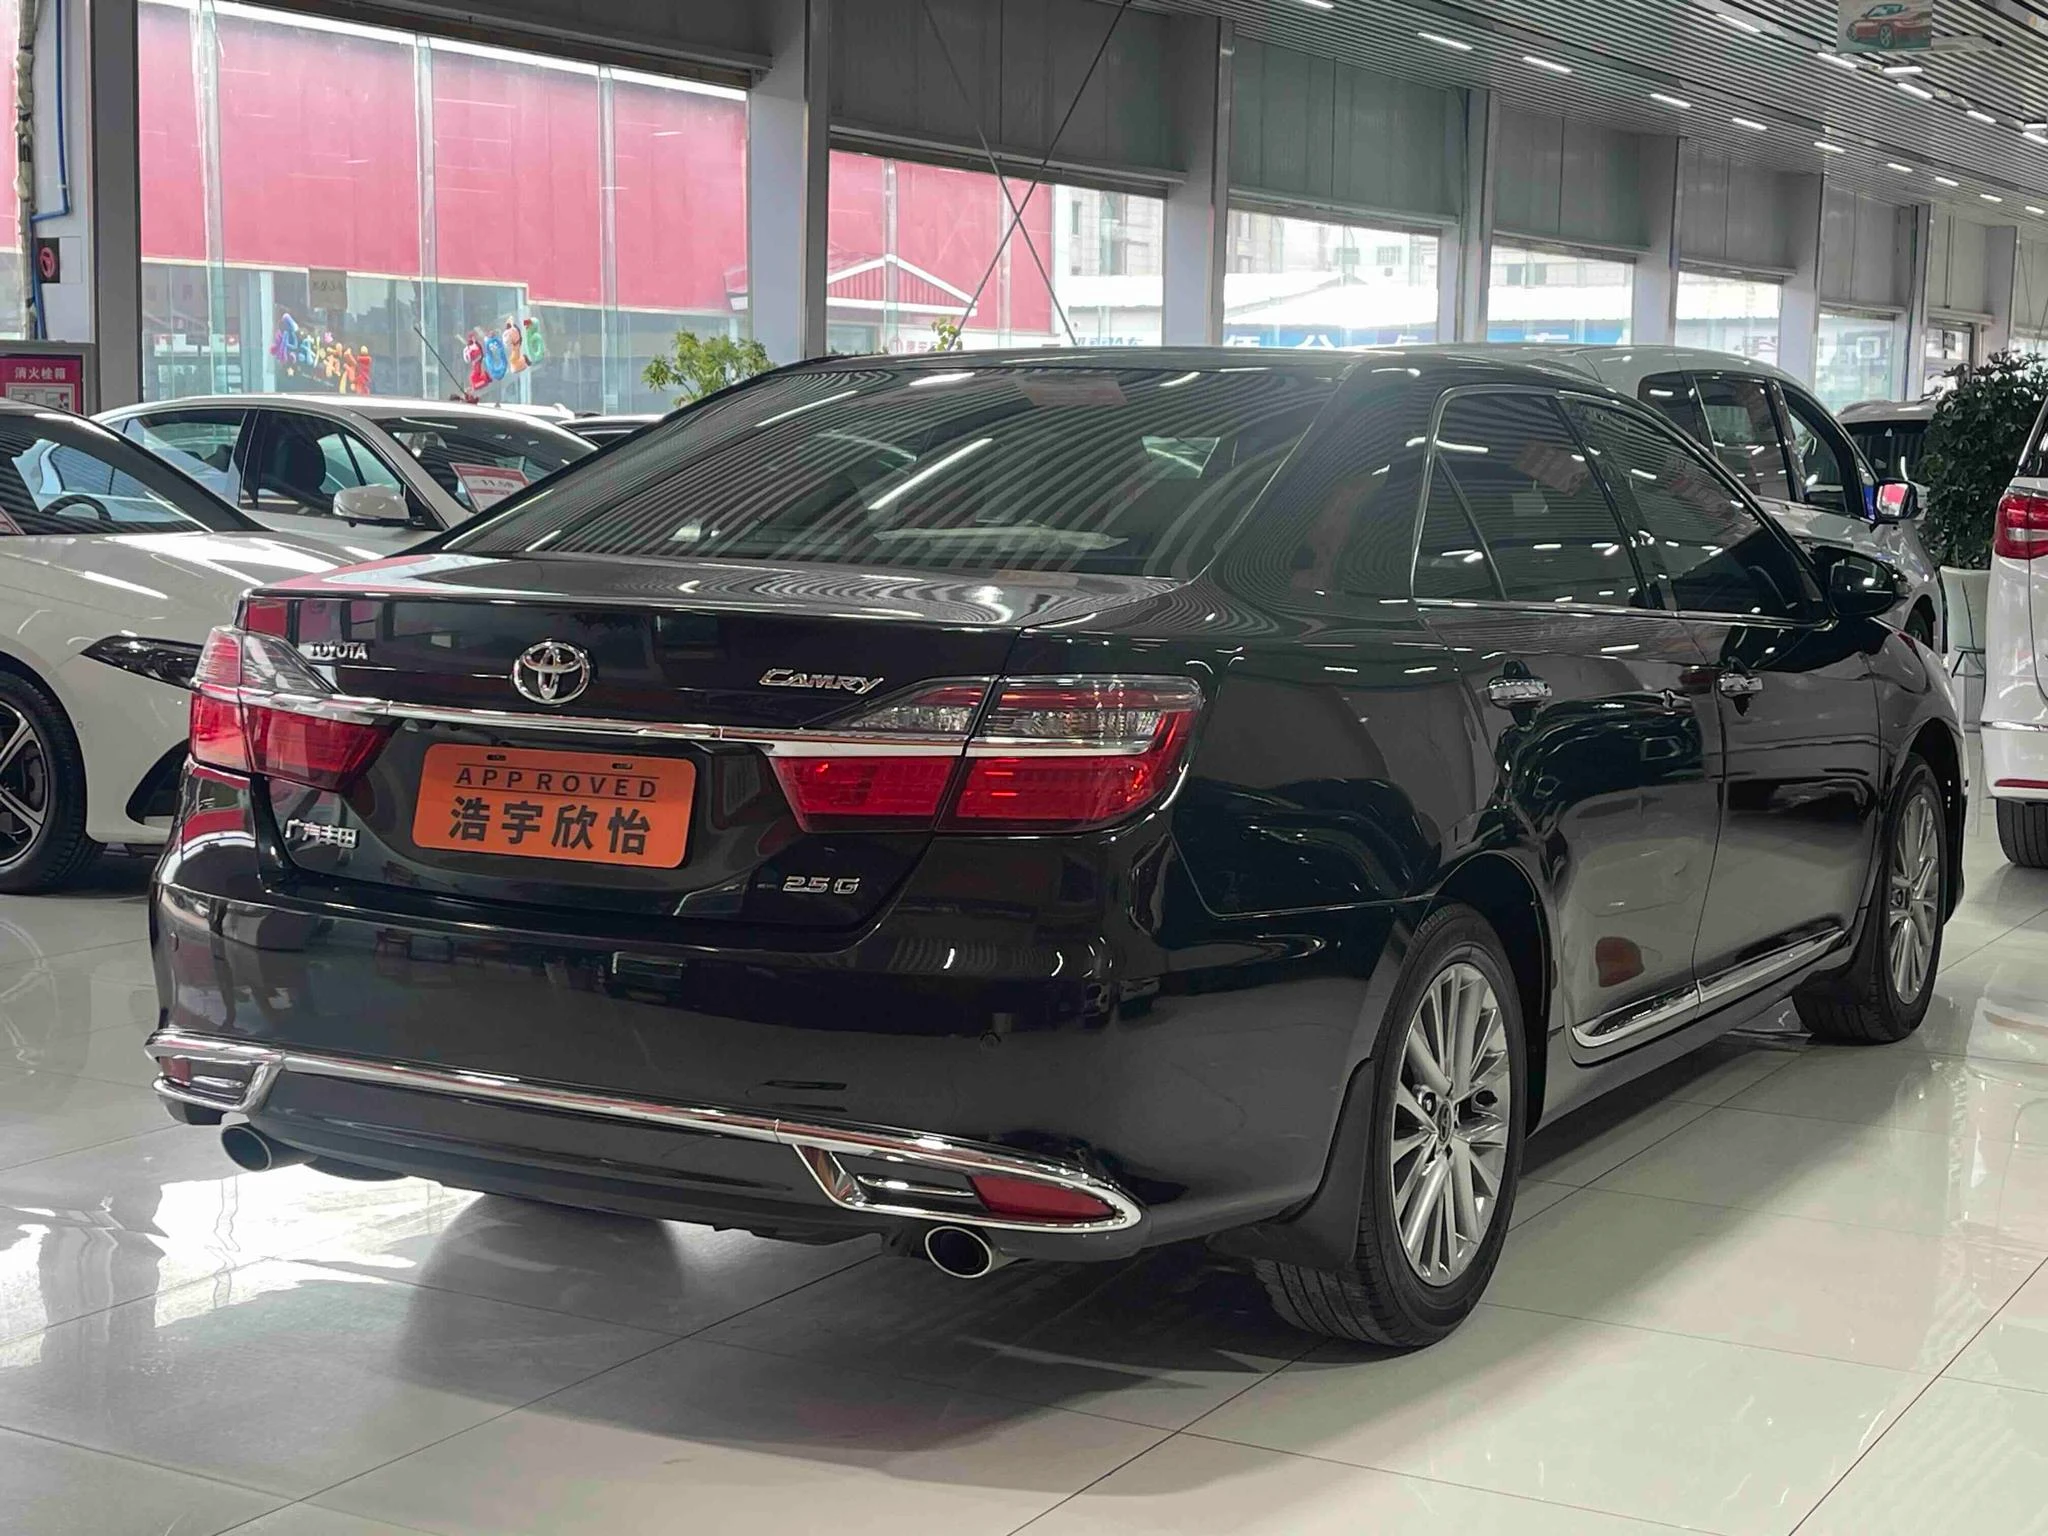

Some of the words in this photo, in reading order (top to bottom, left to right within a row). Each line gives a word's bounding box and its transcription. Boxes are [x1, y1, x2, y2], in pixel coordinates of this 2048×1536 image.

[309, 641, 368, 660] TOYOTA
[759, 668, 884, 694] CAMRY
[456, 767, 656, 798] APPROVED
[285, 819, 357, 849] 广汽丰田
[448, 795, 650, 856] 浩宇欣怡
